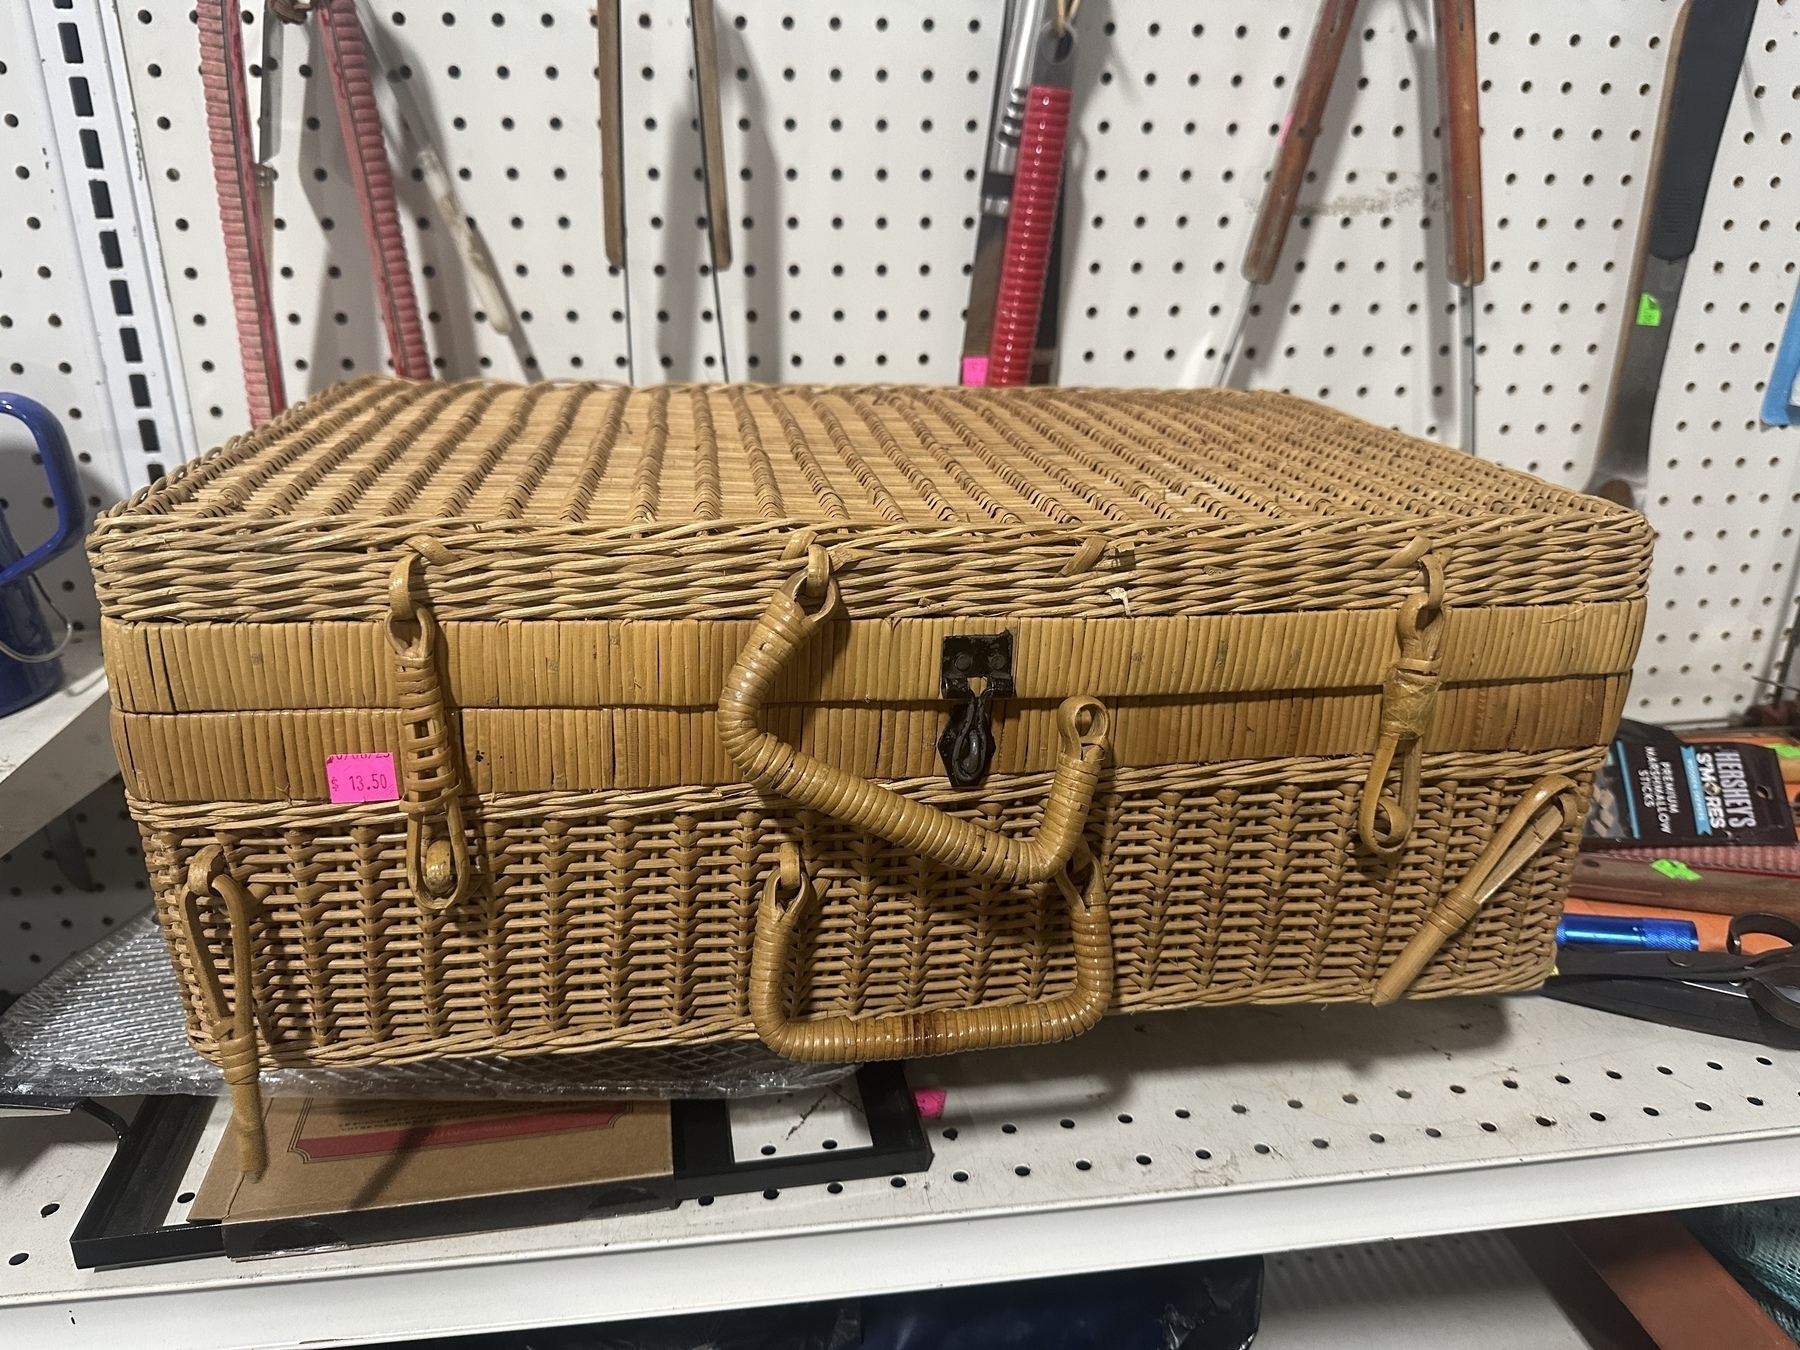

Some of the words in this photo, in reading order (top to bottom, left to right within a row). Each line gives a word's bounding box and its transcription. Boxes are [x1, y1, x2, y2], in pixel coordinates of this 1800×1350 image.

[331, 777, 339, 792] $
[349, 774, 387, 791] 13.50
[1638, 768, 1656, 808] STICKS
[1644, 746, 1672, 834] MARSHMALLOW
[1659, 761, 1680, 814] PREMIUM
[1714, 749, 1757, 828] HERSHEY'S
